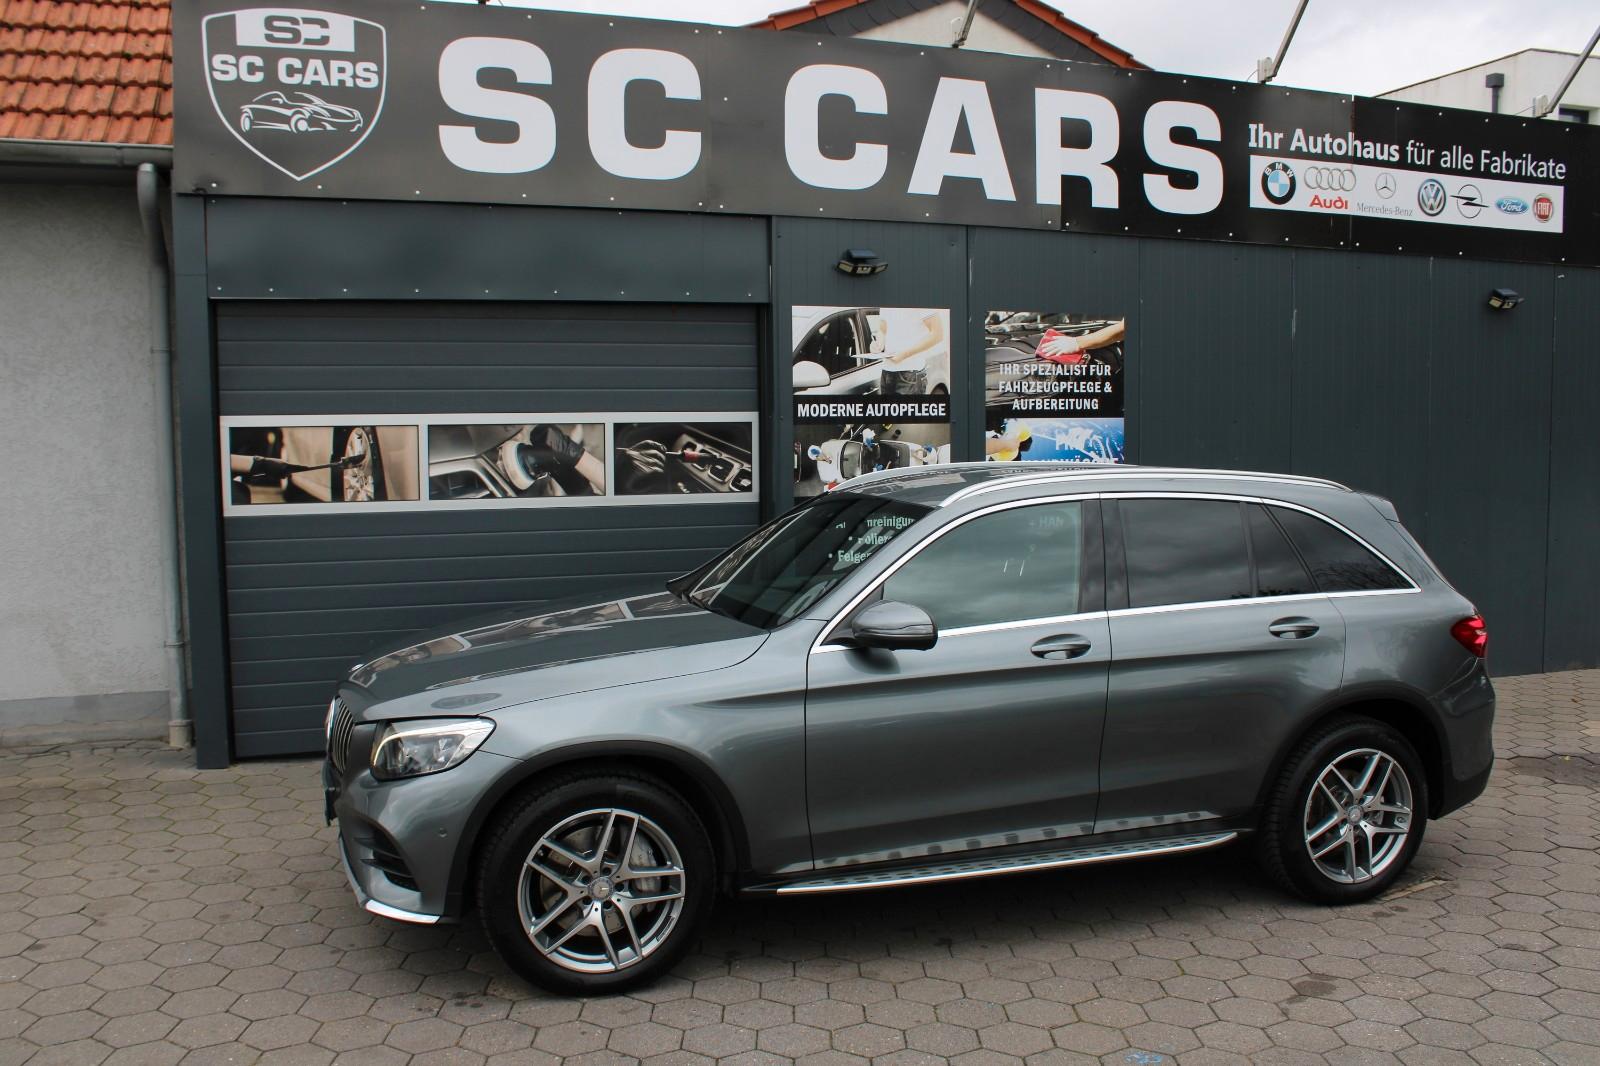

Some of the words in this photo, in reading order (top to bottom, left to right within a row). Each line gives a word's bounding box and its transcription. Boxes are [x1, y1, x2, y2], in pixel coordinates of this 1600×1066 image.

[264, 15, 330, 46] SC
[212, 54, 264, 83] SC
[277, 57, 379, 89] CARS
[438, 36, 702, 180] SC
[784, 64, 1224, 215] CARS
[1248, 123, 1283, 150] Ihr
[1290, 128, 1399, 162] Autohaus
[1406, 140, 1435, 166] für
[1440, 145, 1473, 171] alle
[1480, 149, 1566, 180] Fabrikate
[1309, 194, 1348, 209] Audi
[1537, 201, 1550, 216] FIAT
[1357, 202, 1413, 217] Mercedes-Benz
[1000, 363, 1020, 375] IHR
[1023, 364, 1087, 376] SPEZIALIST
[1090, 363, 1111, 376] FÜR
[998, 381, 1101, 393] FAHRZEUGPFLEGE
[1103, 381, 1112, 393] &
[797, 403, 863, 417] MODERNE
[865, 403, 946, 417] AUTOPFLEGE
[1012, 398, 1099, 410] AUFBEREITUNG
